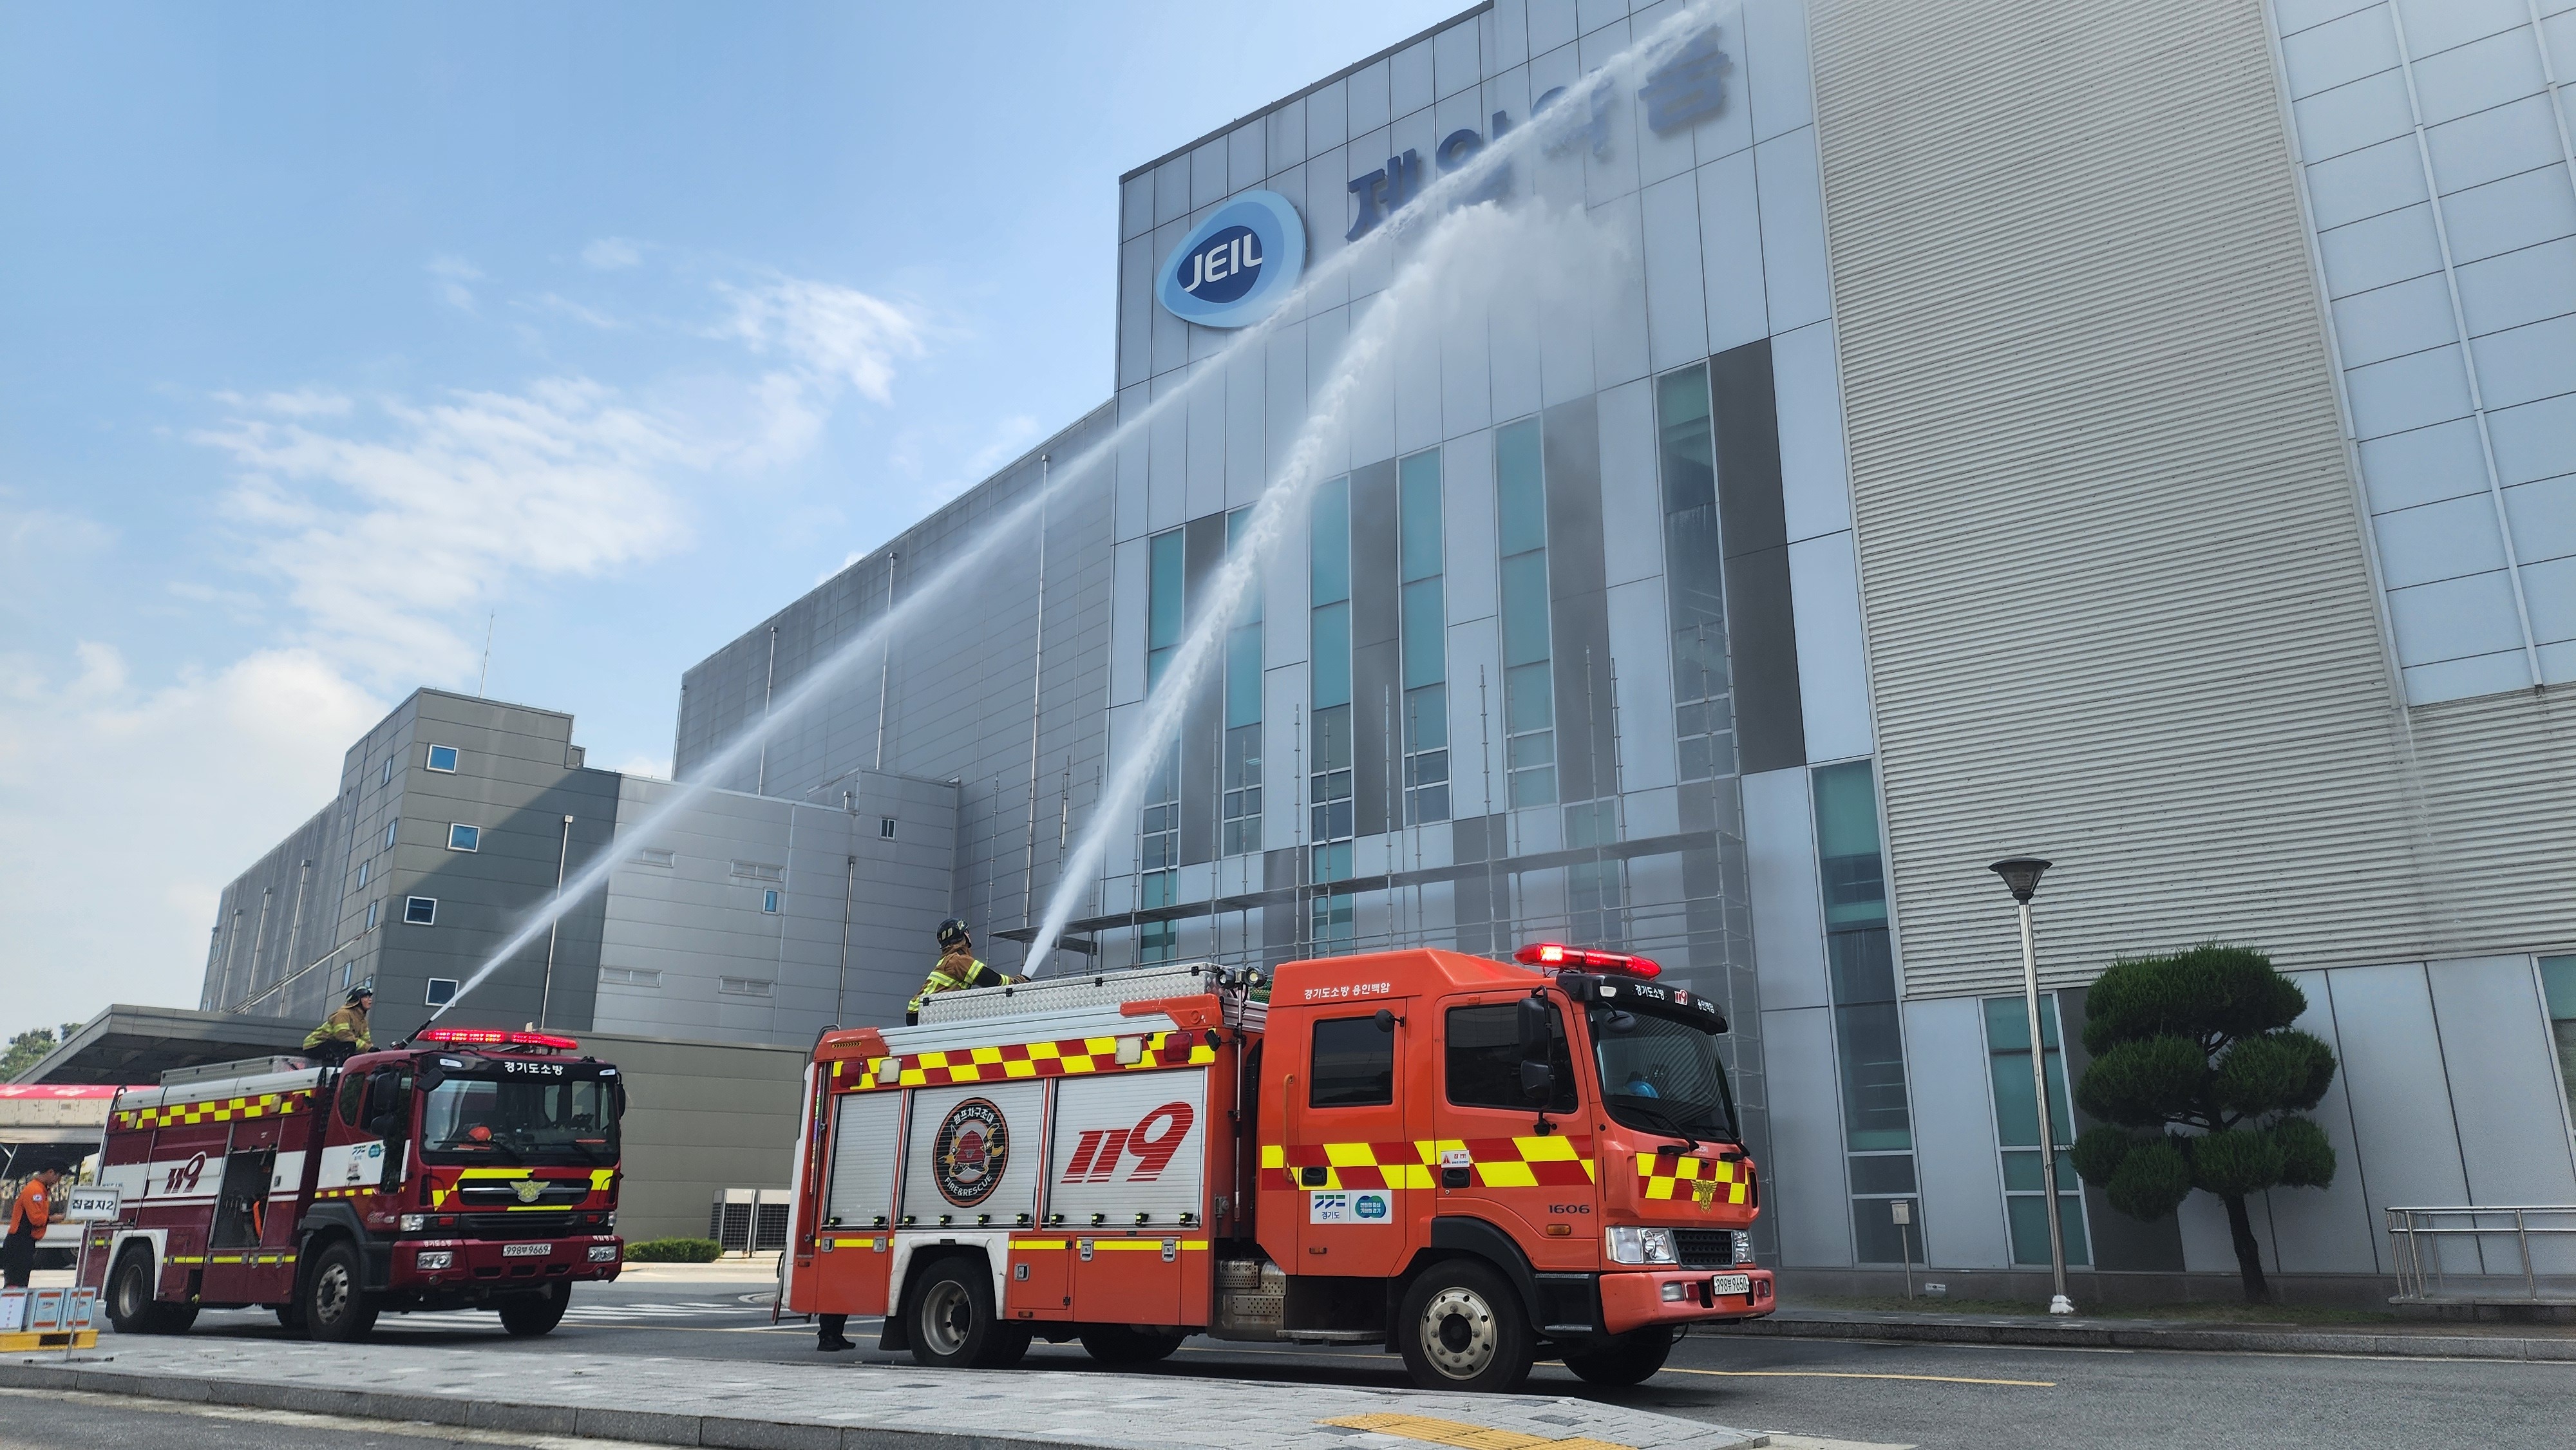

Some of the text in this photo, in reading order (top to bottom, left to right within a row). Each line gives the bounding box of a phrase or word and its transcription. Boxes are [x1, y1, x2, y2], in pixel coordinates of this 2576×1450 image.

[1184, 233, 1263, 293] JEIL
[1304, 983, 1390, 1000] 경기도소방 용인백암
[1634, 984, 1665, 1001] 경기도소방
[1675, 990, 1687, 1005] 119
[504, 1061, 564, 1076] 경기도소방
[953, 1107, 995, 1125] 펌프차구조대
[1060, 1102, 1194, 1183] 119
[164, 1153, 206, 1194] 119
[944, 1174, 993, 1197] FIRE&RESCUE
[1321, 1211, 1340, 1220] 경기도
[1549, 1205, 1590, 1214] 1606
